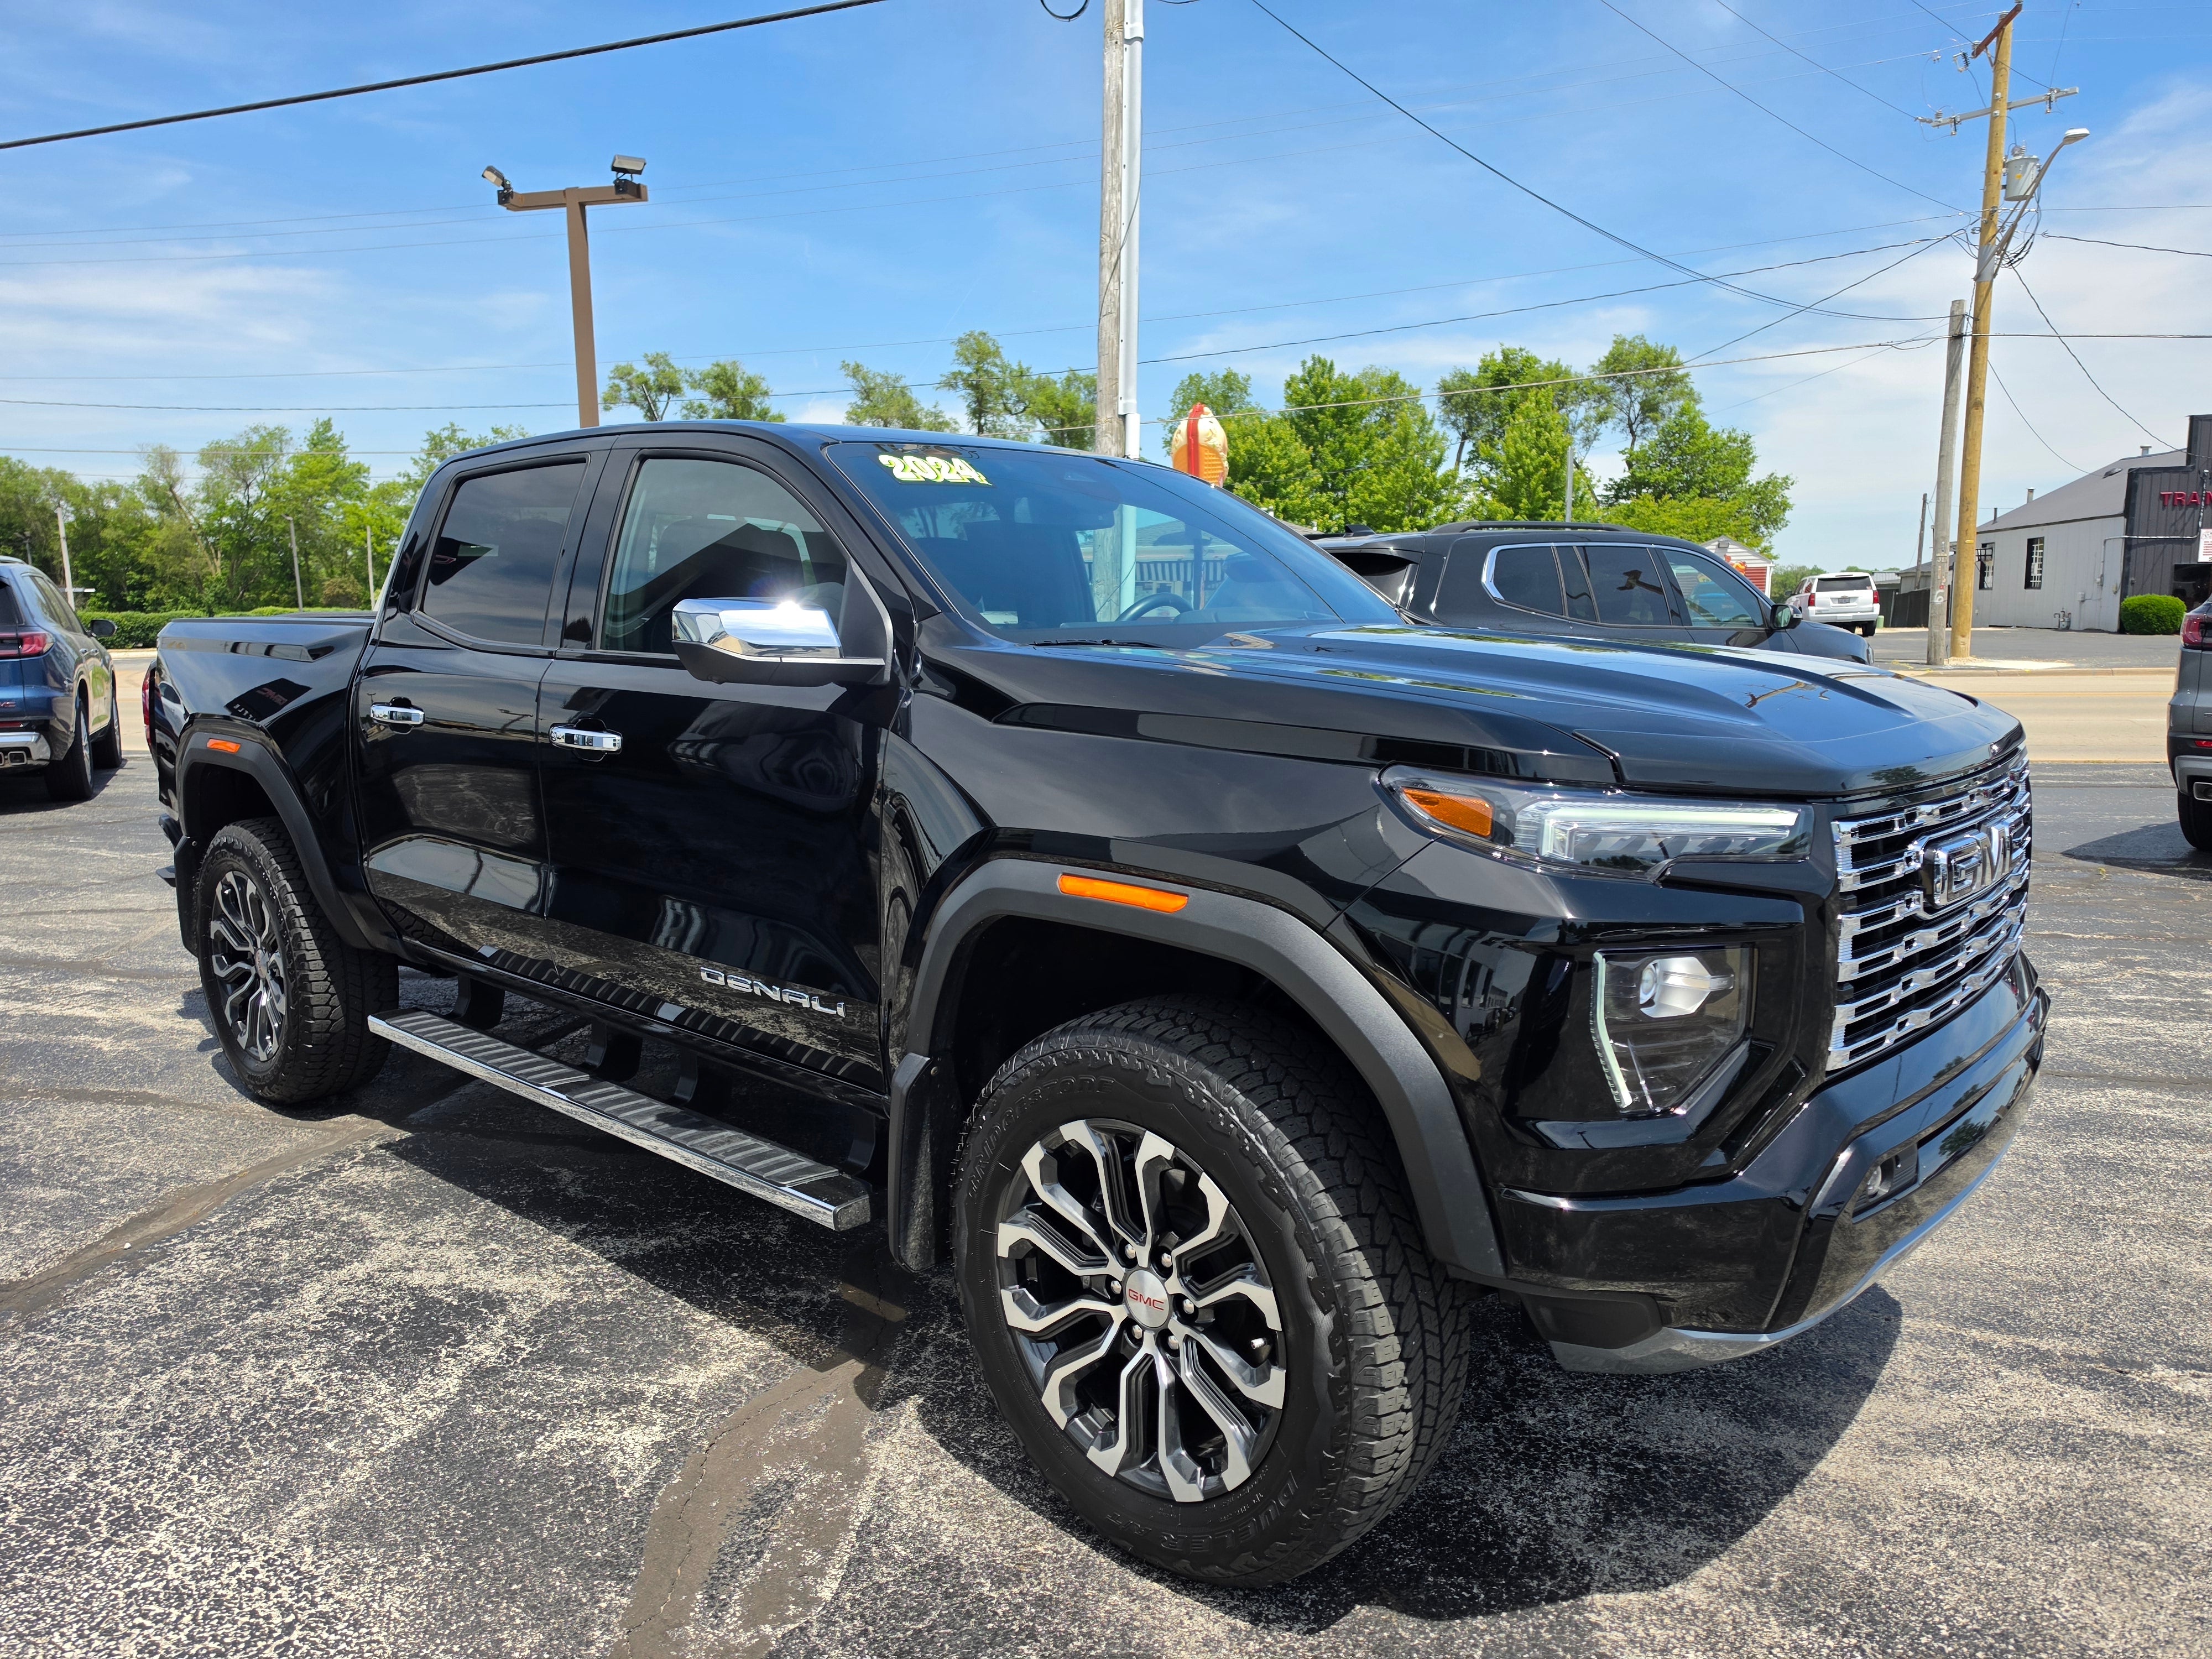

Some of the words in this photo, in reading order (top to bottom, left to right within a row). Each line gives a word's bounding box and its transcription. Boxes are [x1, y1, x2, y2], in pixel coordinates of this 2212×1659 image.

[878, 455, 993, 486] 2024
[1934, 812, 2026, 907] GMC
[700, 967, 846, 1018] DENALI
[1128, 1288, 1164, 1311] GMC
[1159, 1469, 1300, 1553] DUELER
